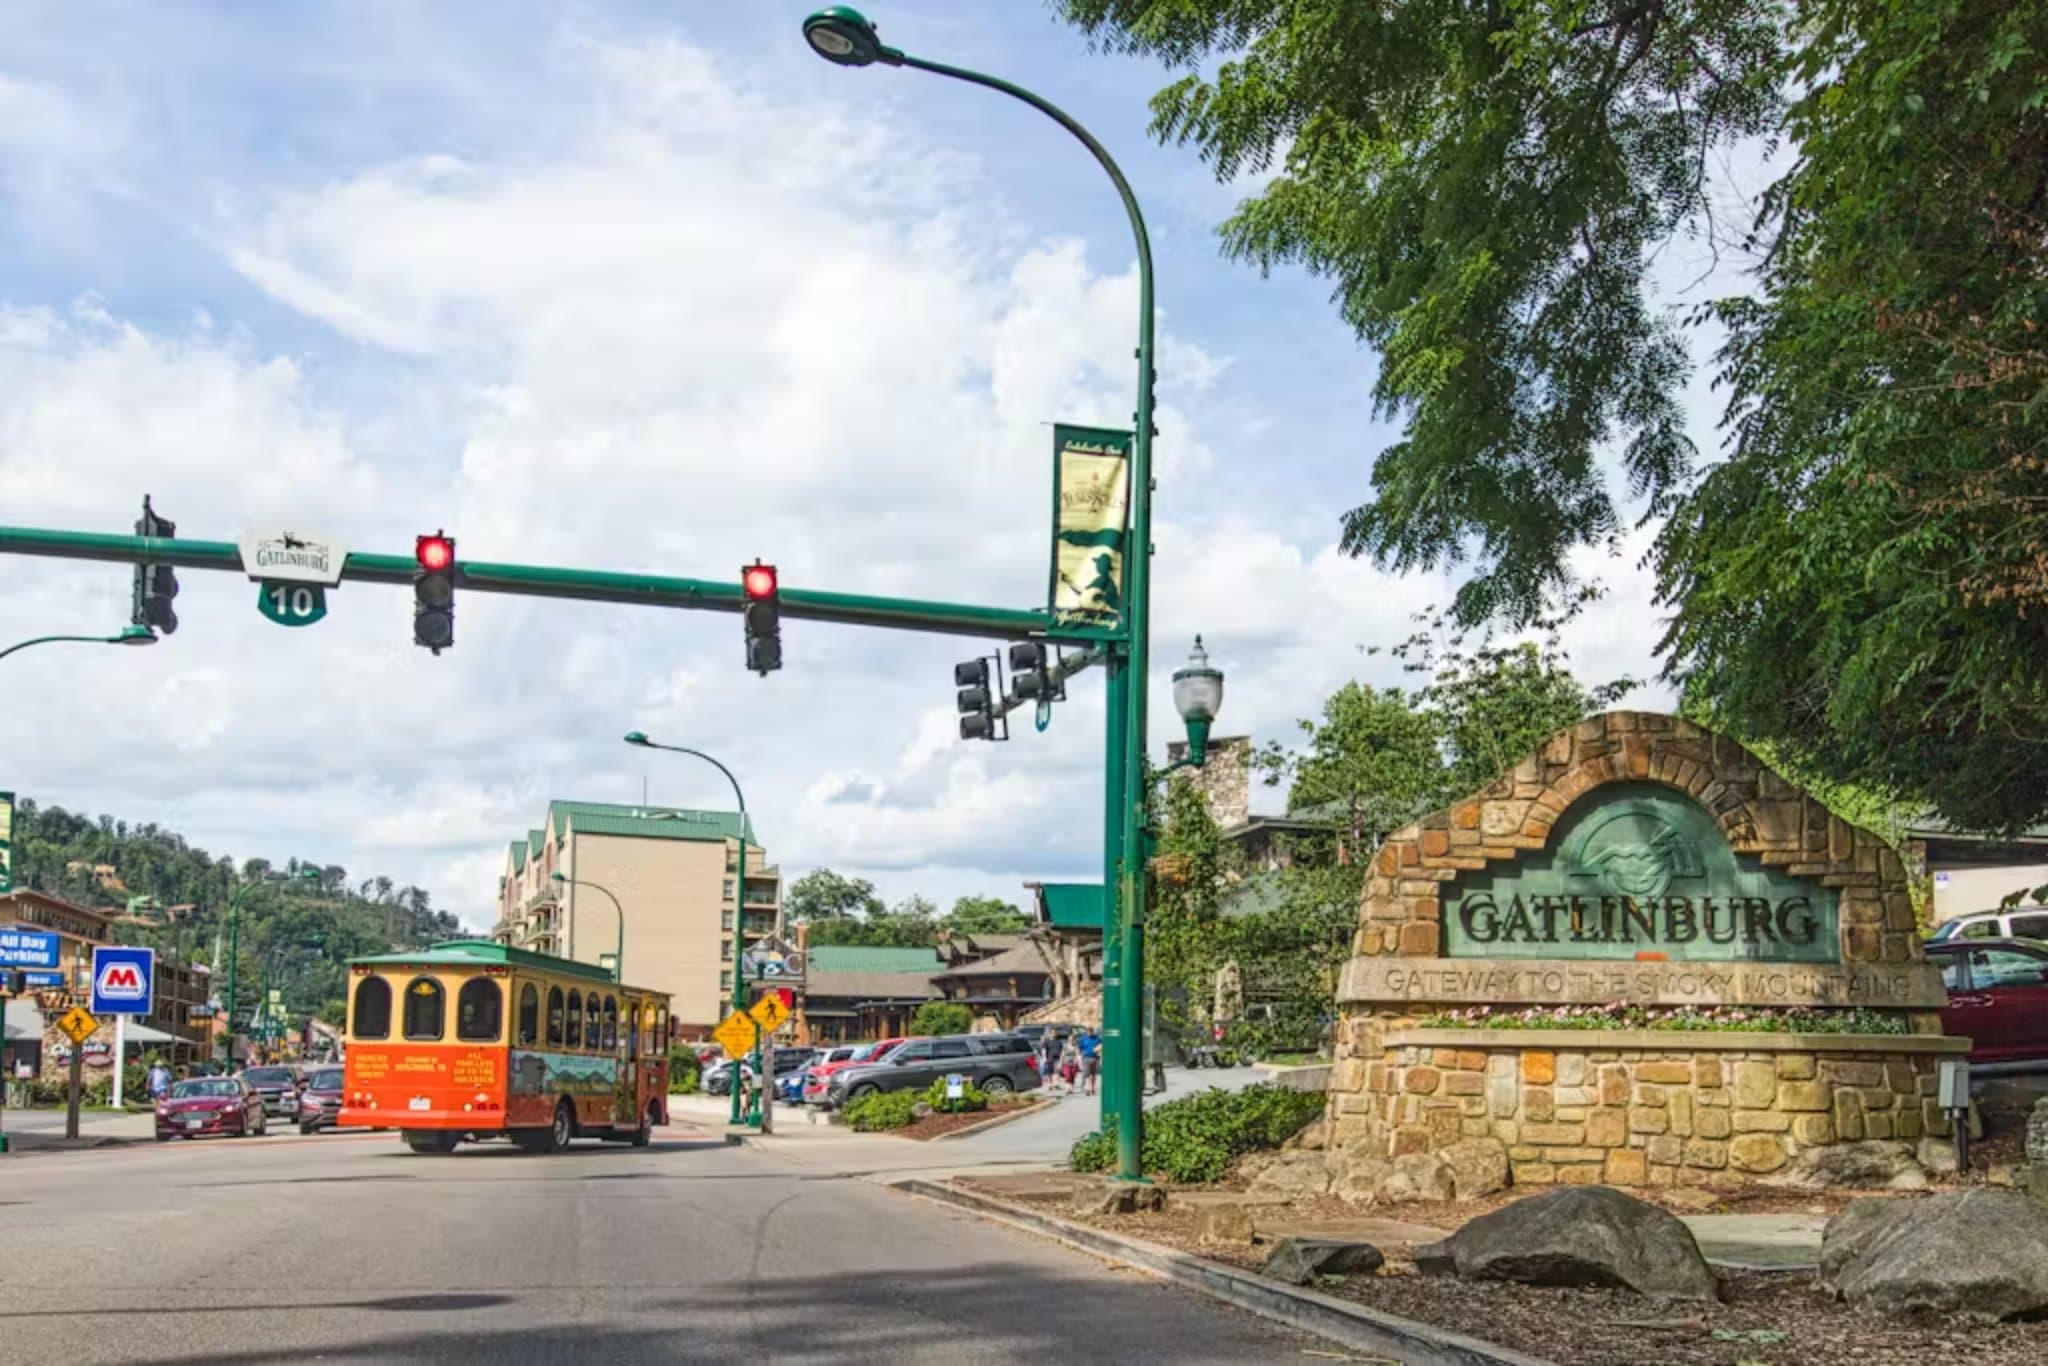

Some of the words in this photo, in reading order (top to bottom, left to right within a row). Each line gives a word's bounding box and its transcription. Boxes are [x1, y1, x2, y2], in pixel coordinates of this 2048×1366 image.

[257, 546, 328, 572] GATLINBURG
[271, 586, 313, 616] 10
[1459, 892, 1820, 945] GATLINBURG
[21, 935, 47, 950] Day
[1384, 969, 1520, 993] GATEWAY
[1525, 971, 1564, 994] TO
[1569, 972, 1627, 995] THE
[1634, 972, 1734, 996] SMOKY
[1743, 973, 1910, 997] MOUNTAINS
